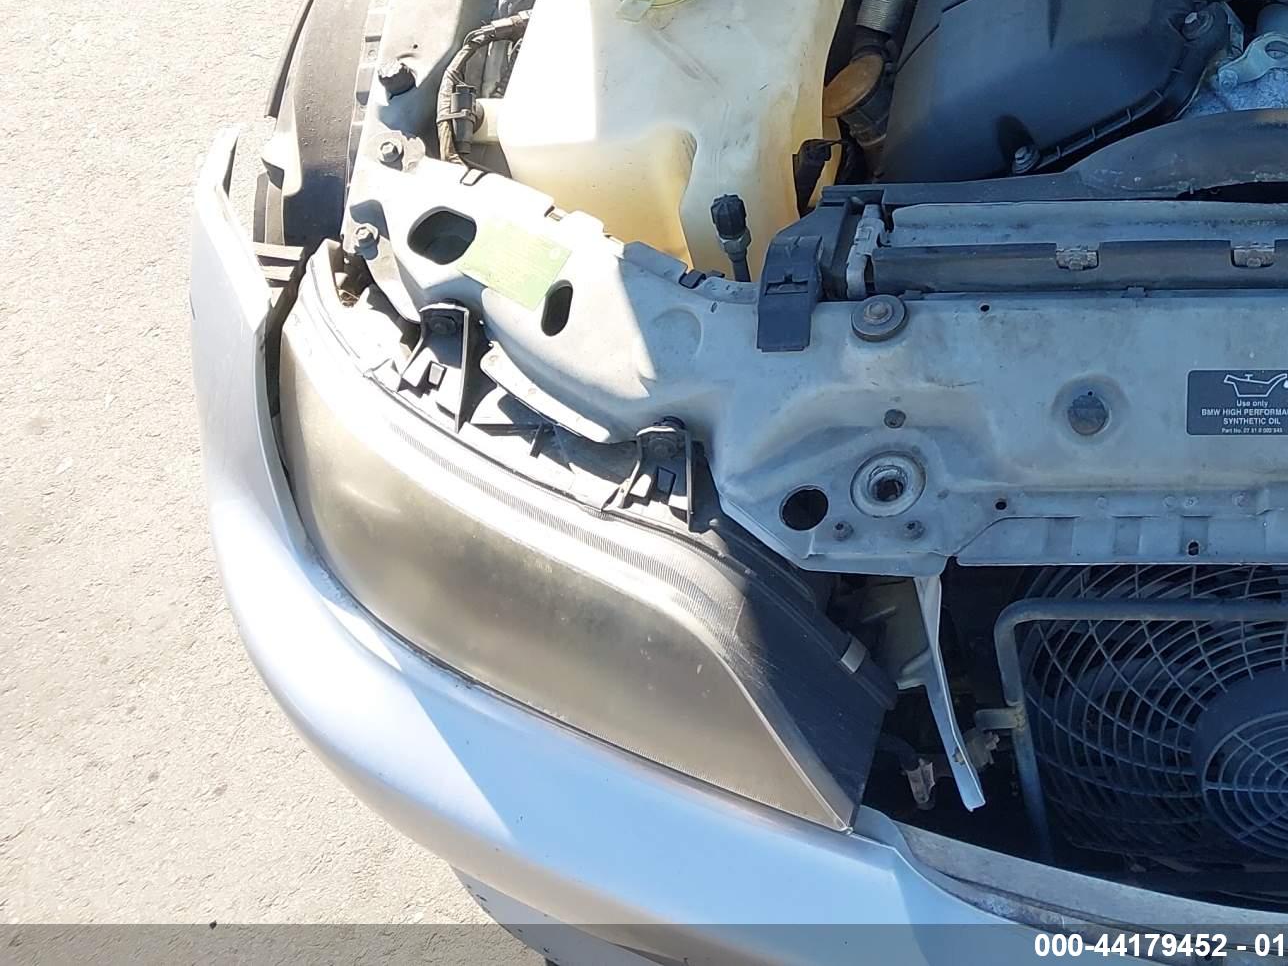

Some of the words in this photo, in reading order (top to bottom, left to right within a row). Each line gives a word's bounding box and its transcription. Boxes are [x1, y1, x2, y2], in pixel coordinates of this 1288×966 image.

[1236, 400, 1251, 408] Use
[1252, 400, 1269, 408] only
[1201, 408, 1220, 416] BMW
[1222, 408, 1242, 416] HIGH
[1223, 417, 1266, 425] SYNTHETIC
[1268, 417, 1281, 425] OIL
